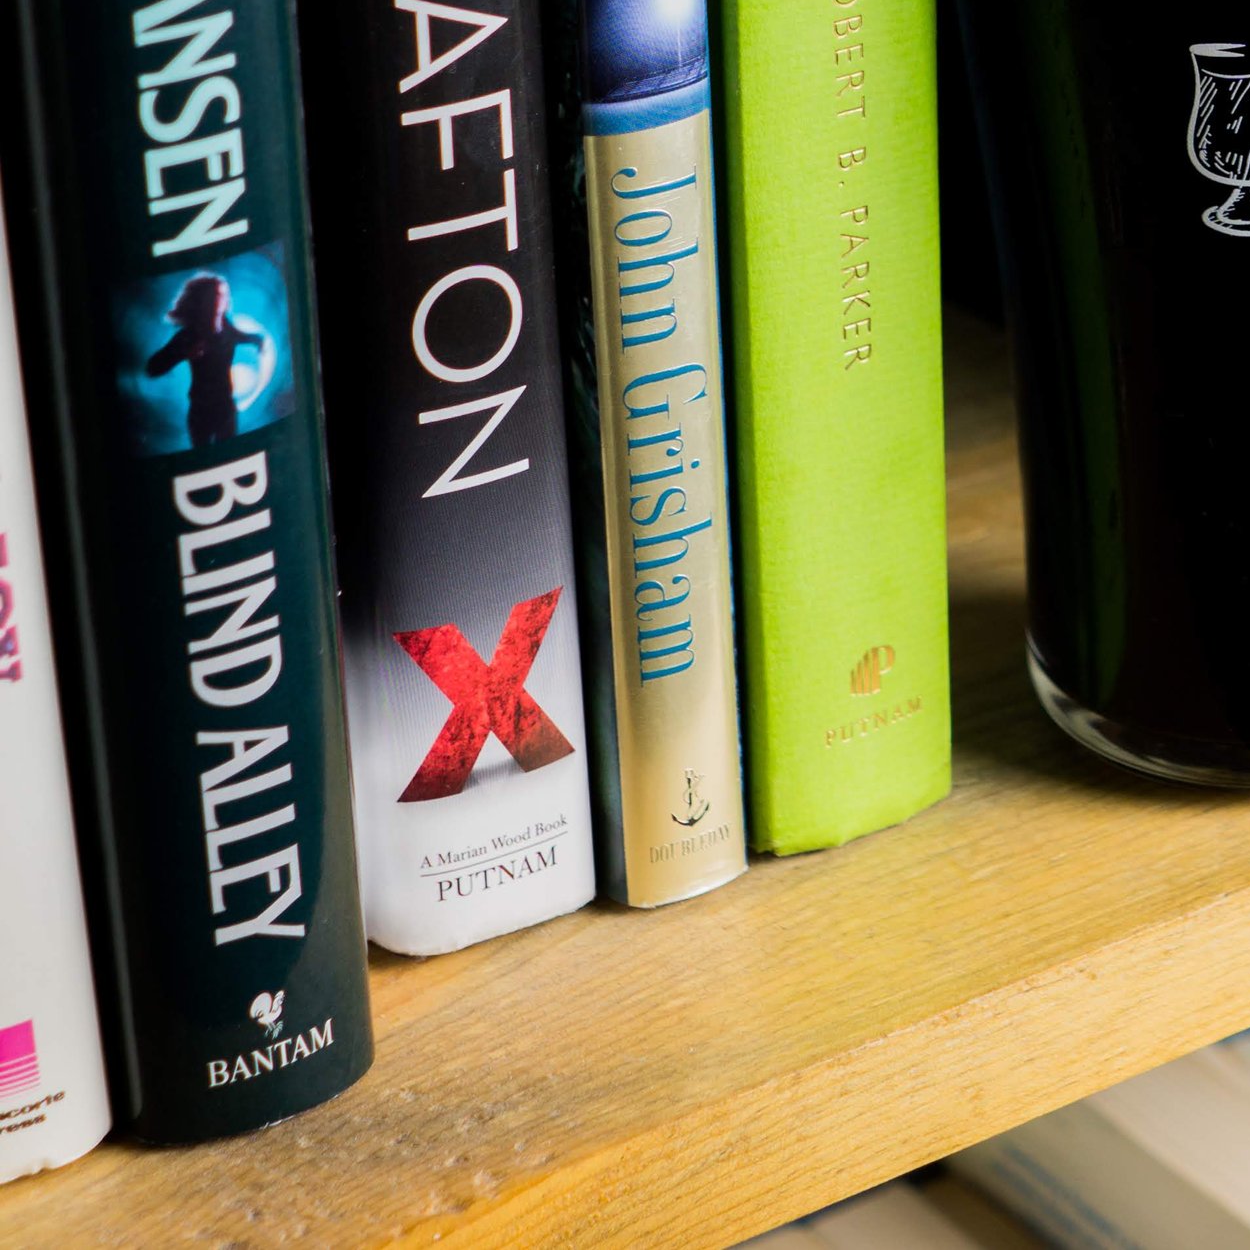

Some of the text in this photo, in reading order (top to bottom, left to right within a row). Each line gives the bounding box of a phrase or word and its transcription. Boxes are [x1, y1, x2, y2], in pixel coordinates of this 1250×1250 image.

[837, 147, 867, 188] B.
[840, 205, 872, 370] PARKER
[611, 164, 713, 686] John Grisham
[173, 451, 306, 946] BLIND ALLEY
[393, 586, 575, 802] X
[824, 695, 924, 749] PUTNAM
[421, 814, 568, 869] A Marian Wood Book
[437, 845, 558, 901] PUTNAM
[649, 824, 731, 863] DOUBLEDAY
[206, 1017, 335, 1089] BANTAM
